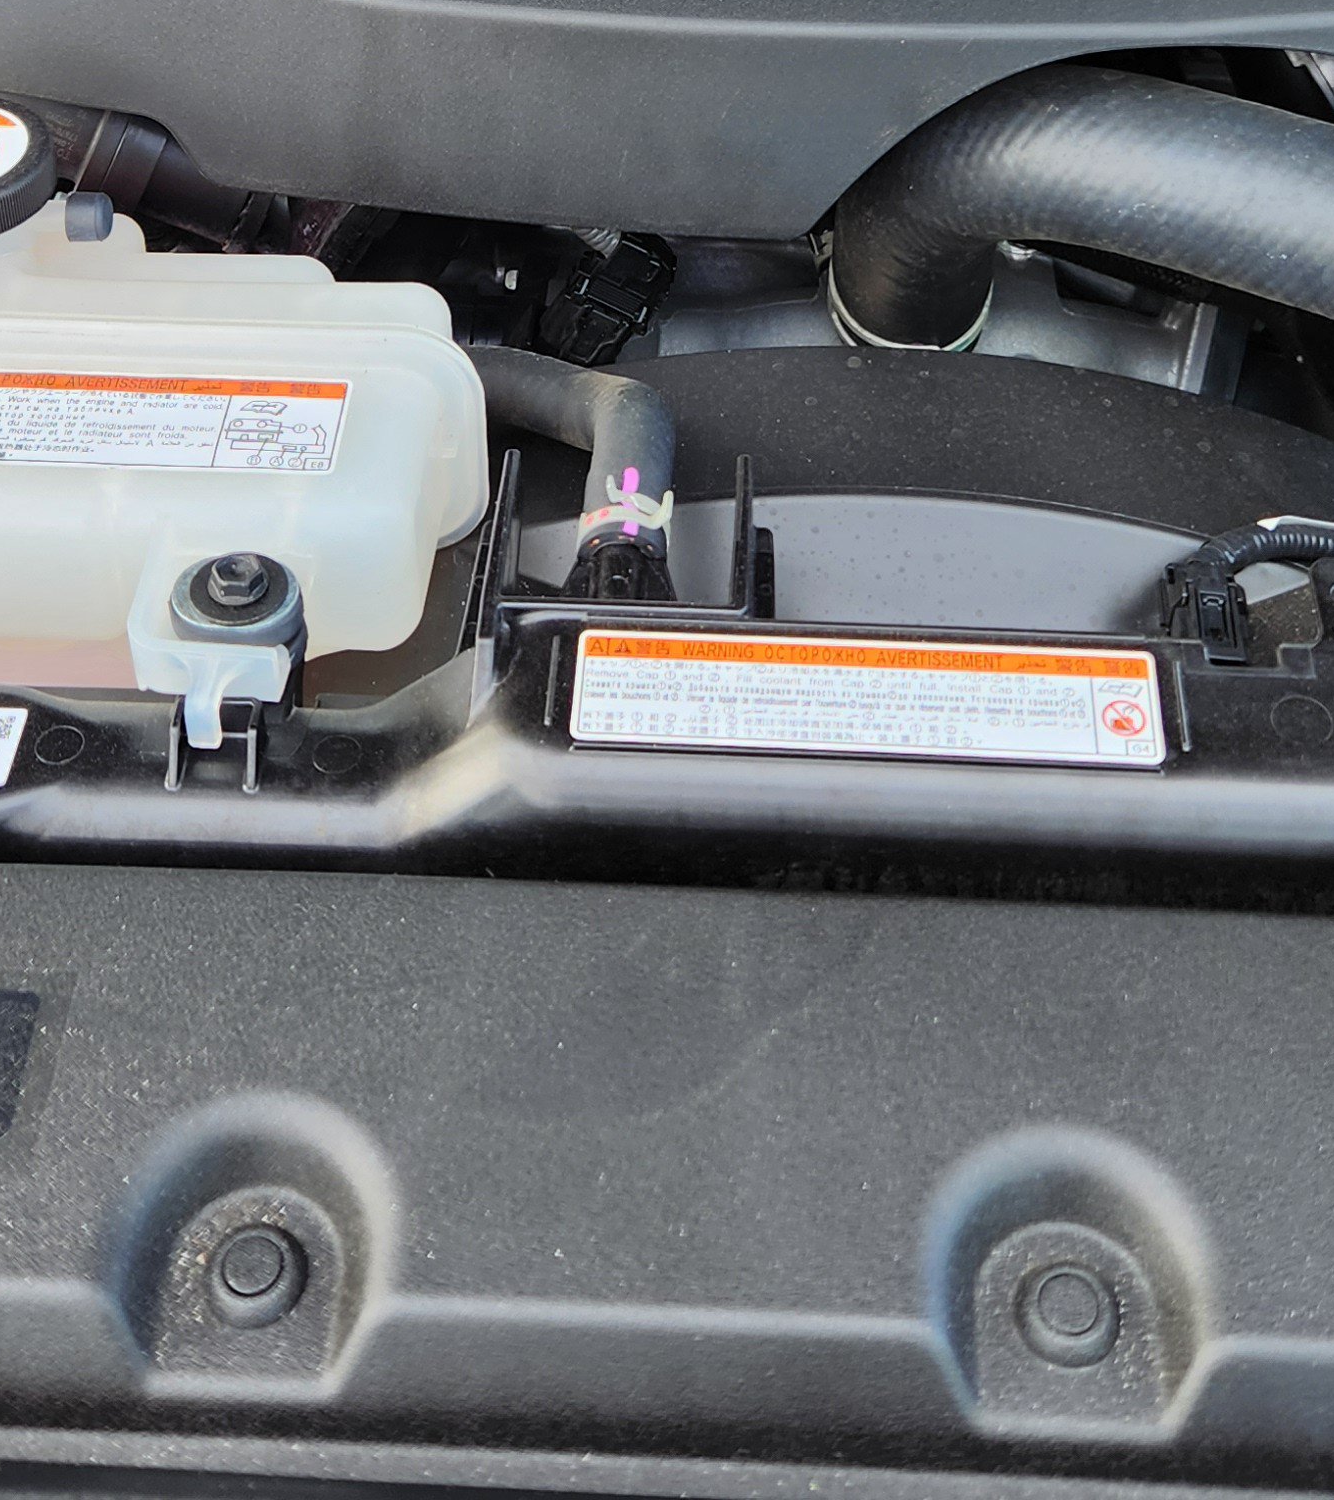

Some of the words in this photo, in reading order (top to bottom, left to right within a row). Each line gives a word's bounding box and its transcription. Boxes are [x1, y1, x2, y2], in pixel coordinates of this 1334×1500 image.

[64, 377, 187, 390] AVERTISSEMENT
[7, 427, 42, 435] moteur
[77, 429, 123, 438] radiateur
[81, 422, 156, 430] refroidissement
[682, 642, 753, 658] WARNING
[764, 646, 865, 663] ОСТОРОЖНО
[876, 651, 1002, 669] AVERTISSEMENT
[586, 668, 628, 677] Remove
[636, 670, 658, 679] Cap
[682, 672, 702, 681] and
[759, 675, 801, 685] coolant
[809, 678, 833, 686] from
[841, 679, 863, 688] Cap
[887, 681, 910, 690] until
[949, 684, 981, 693] Install
[989, 685, 1012, 694] Cap
[1035, 687, 1057, 696] and
